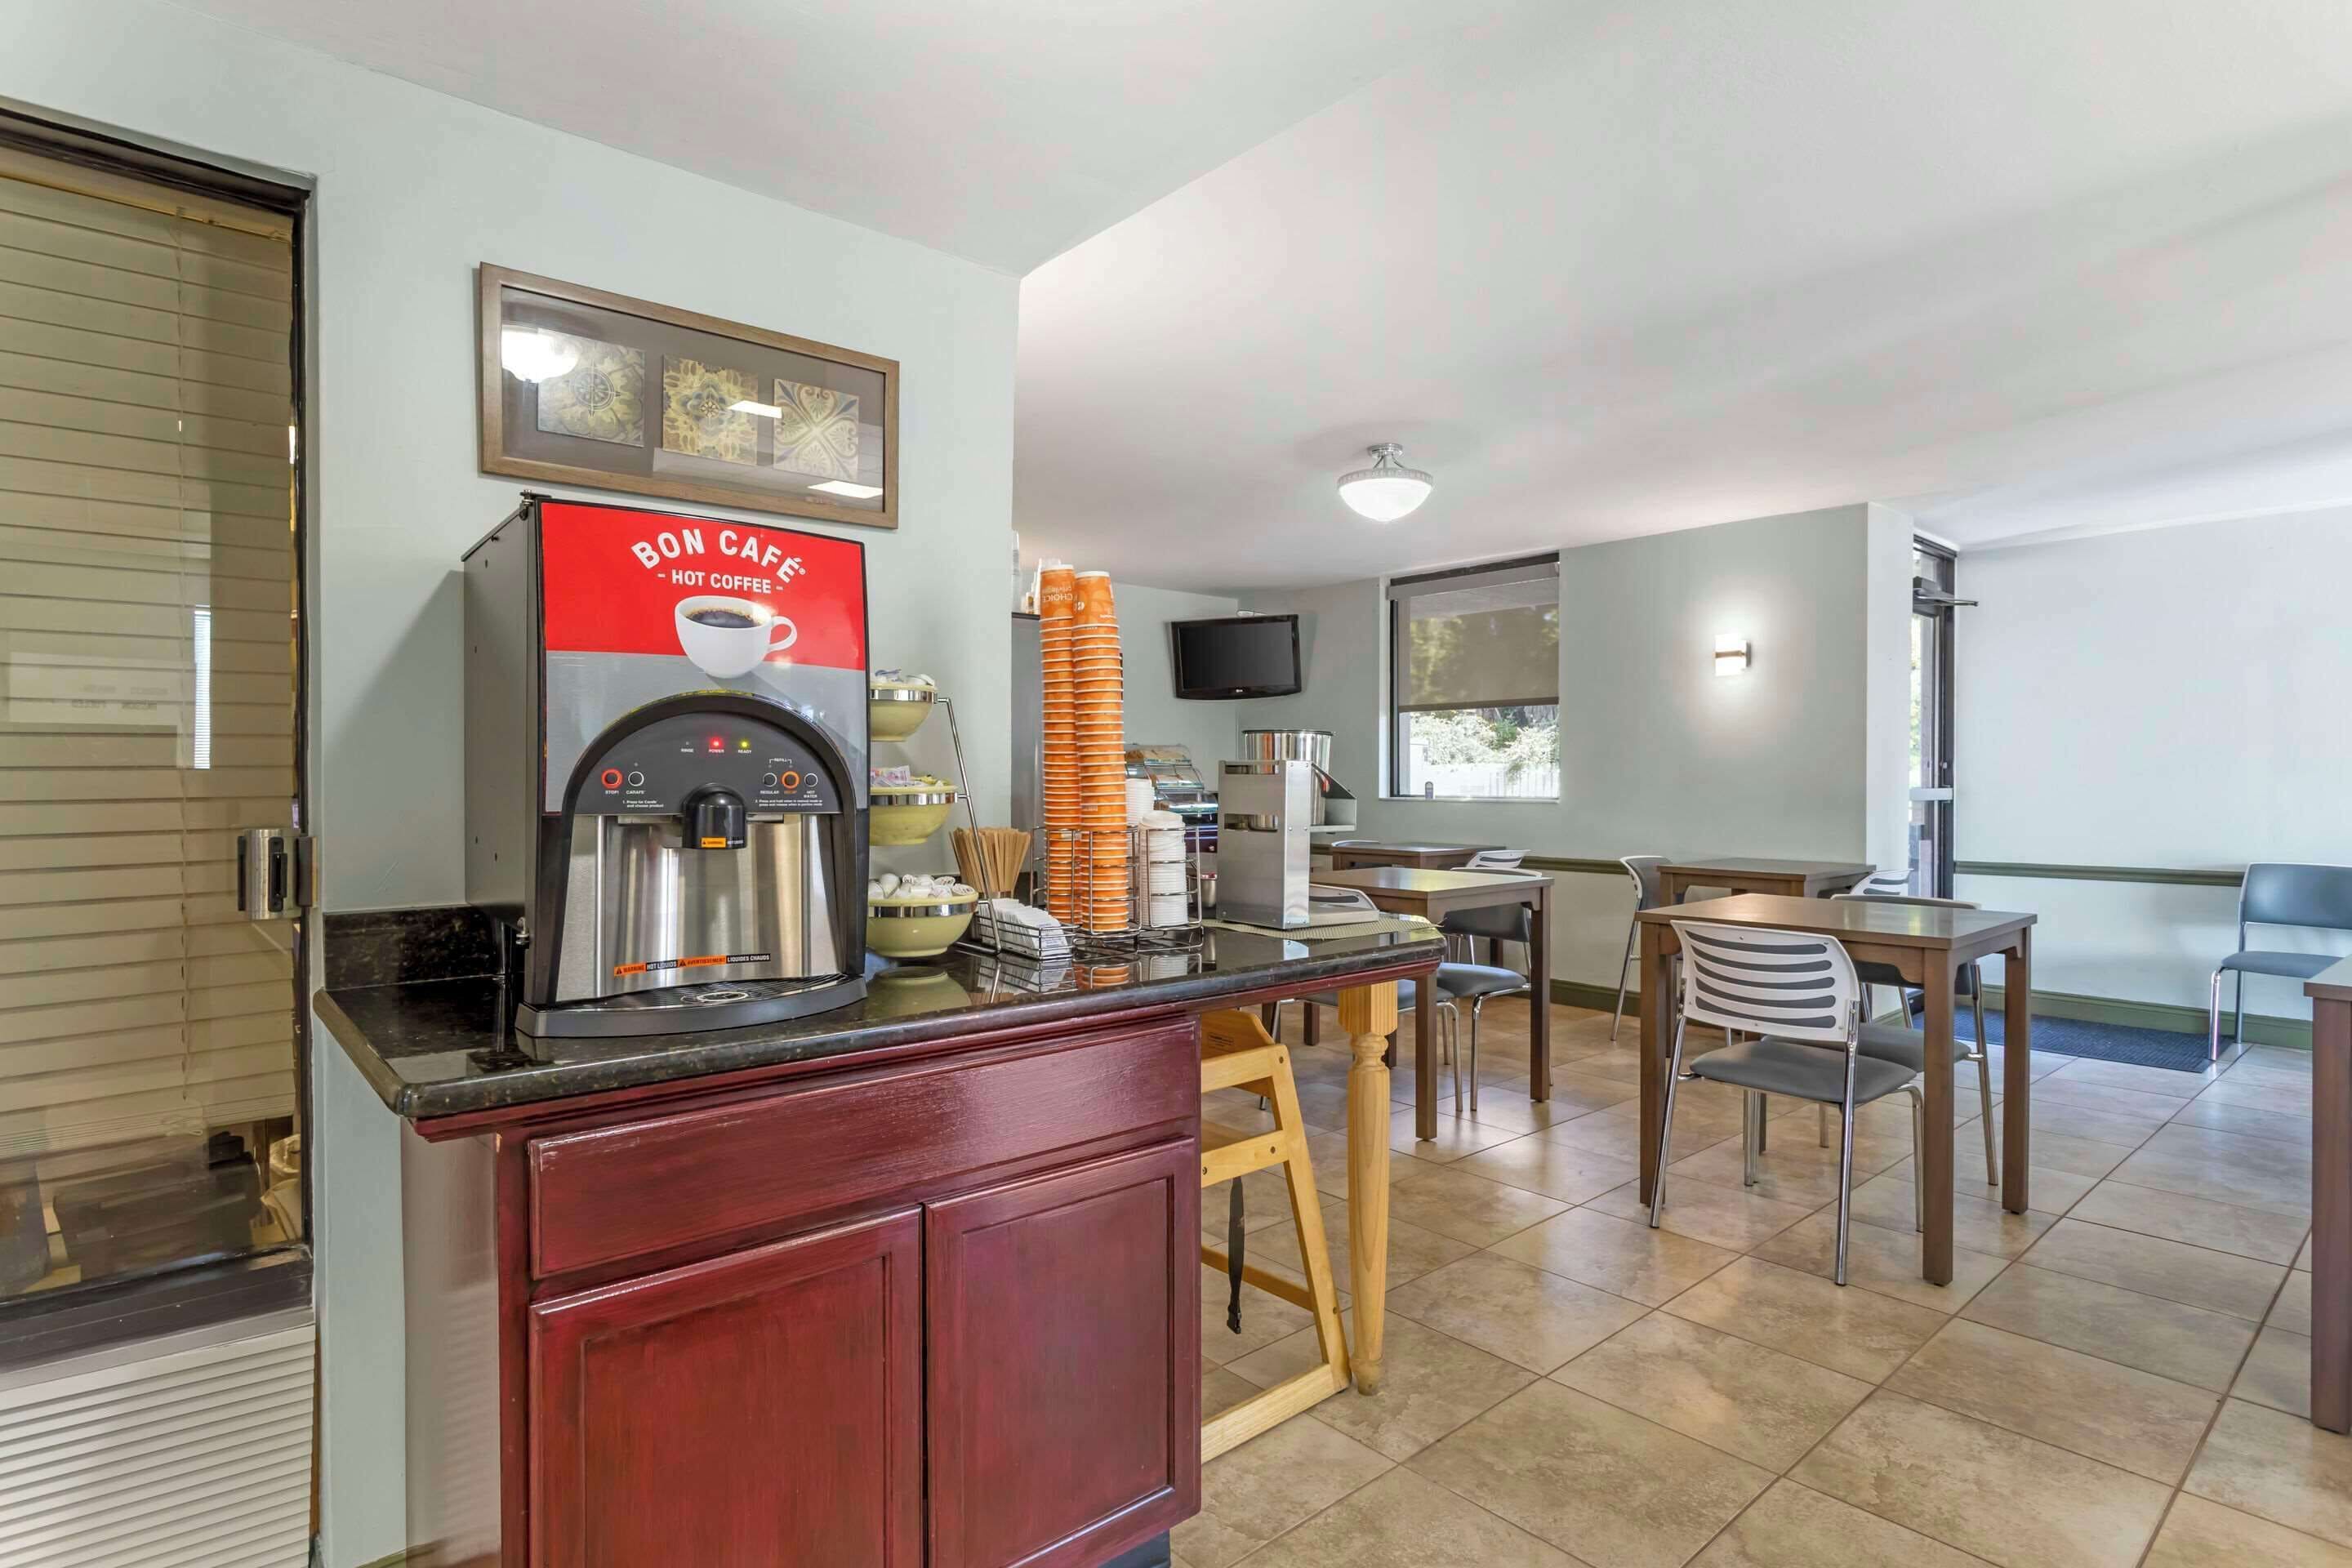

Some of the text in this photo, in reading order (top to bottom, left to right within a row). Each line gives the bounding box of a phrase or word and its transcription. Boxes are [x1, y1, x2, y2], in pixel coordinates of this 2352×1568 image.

[631, 528, 706, 569] BON
[671, 568, 772, 595] HOT COFFEE
[658, 961, 677, 969] LIQUIDS
